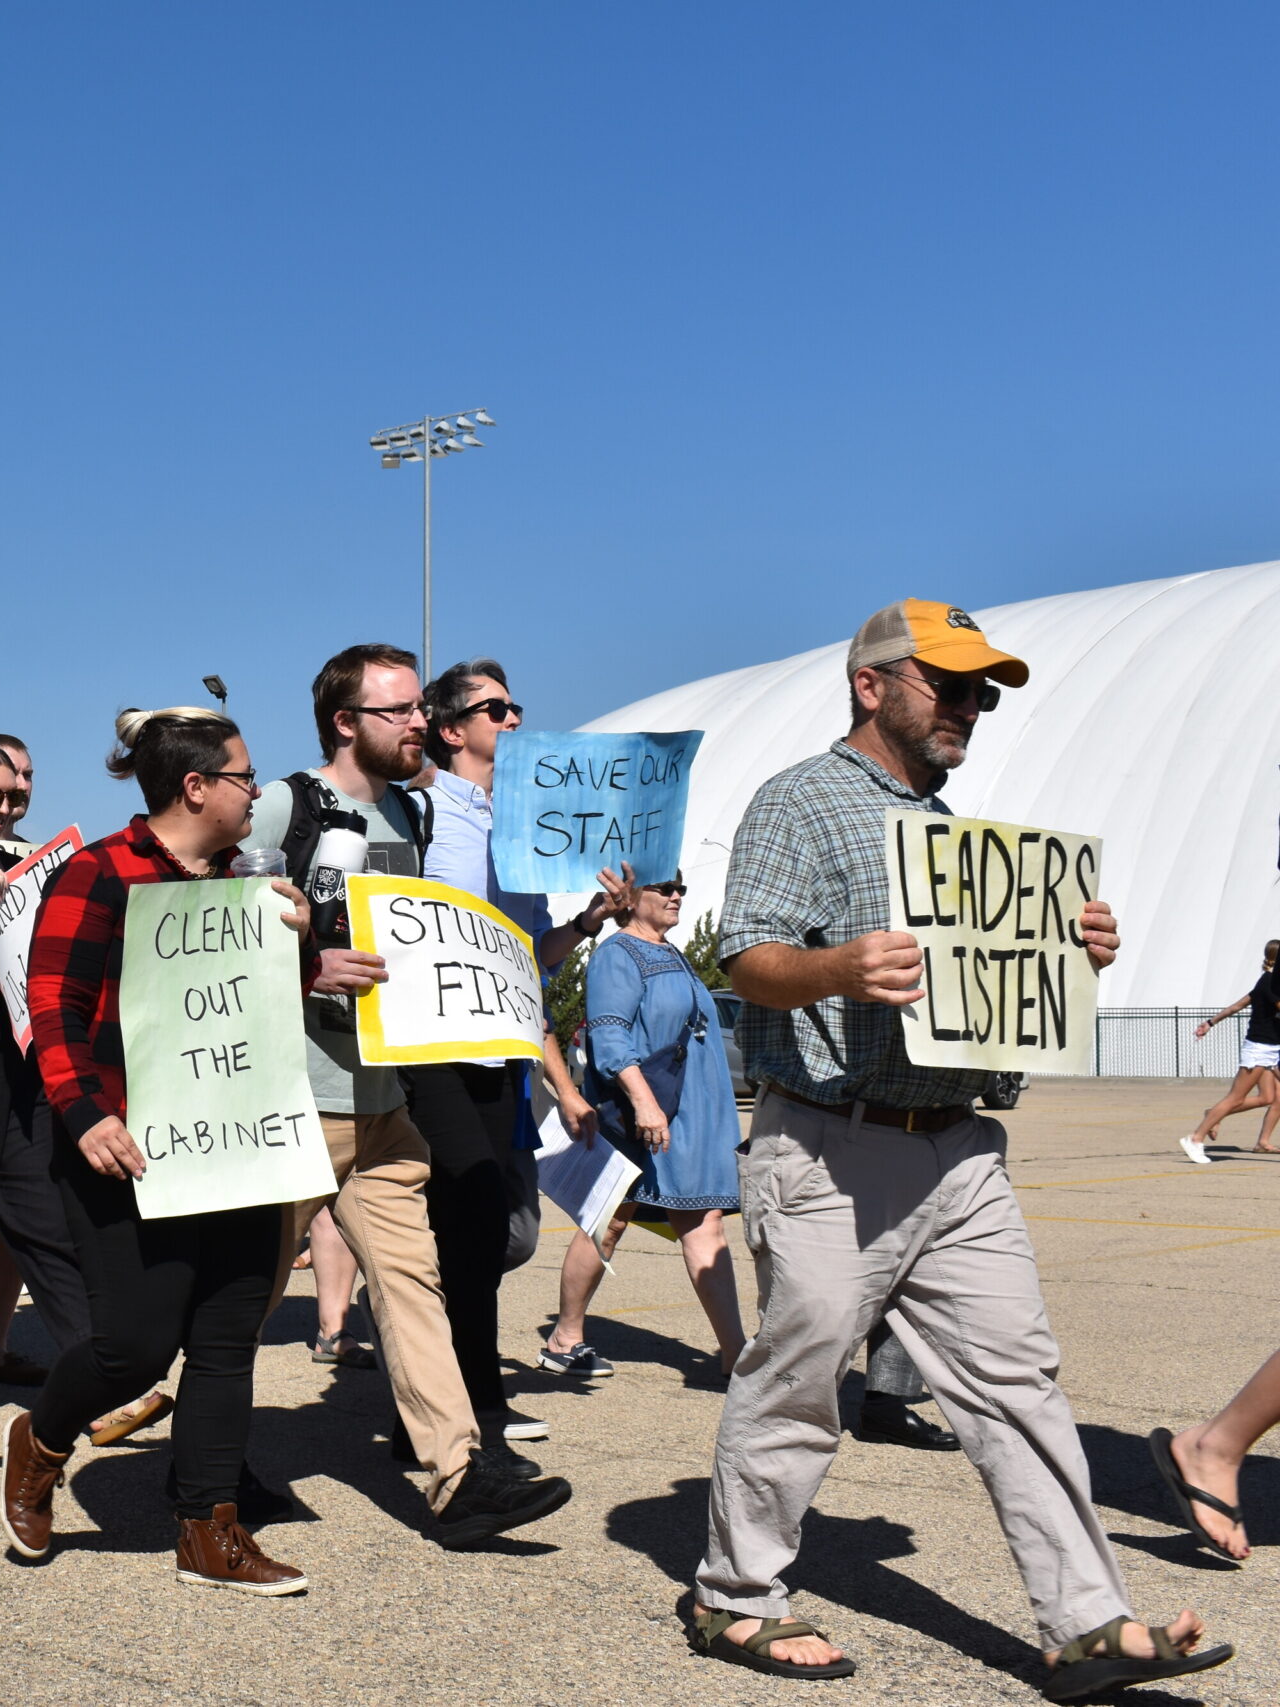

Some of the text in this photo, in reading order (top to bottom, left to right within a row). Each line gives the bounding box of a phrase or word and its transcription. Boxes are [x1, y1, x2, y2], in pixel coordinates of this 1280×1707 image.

[534, 749, 685, 791] SAVE OUR
[533, 809, 663, 857] STAFF
[896, 818, 1096, 949] LEADERS
[154, 904, 263, 960] CLEAN
[390, 897, 540, 991] STUDENT
[184, 975, 249, 1021] OUT
[432, 961, 541, 1030] FIRST
[924, 946, 1066, 1051] LISTEN
[180, 1041, 252, 1080] THE
[144, 1112, 306, 1161] CABINET
